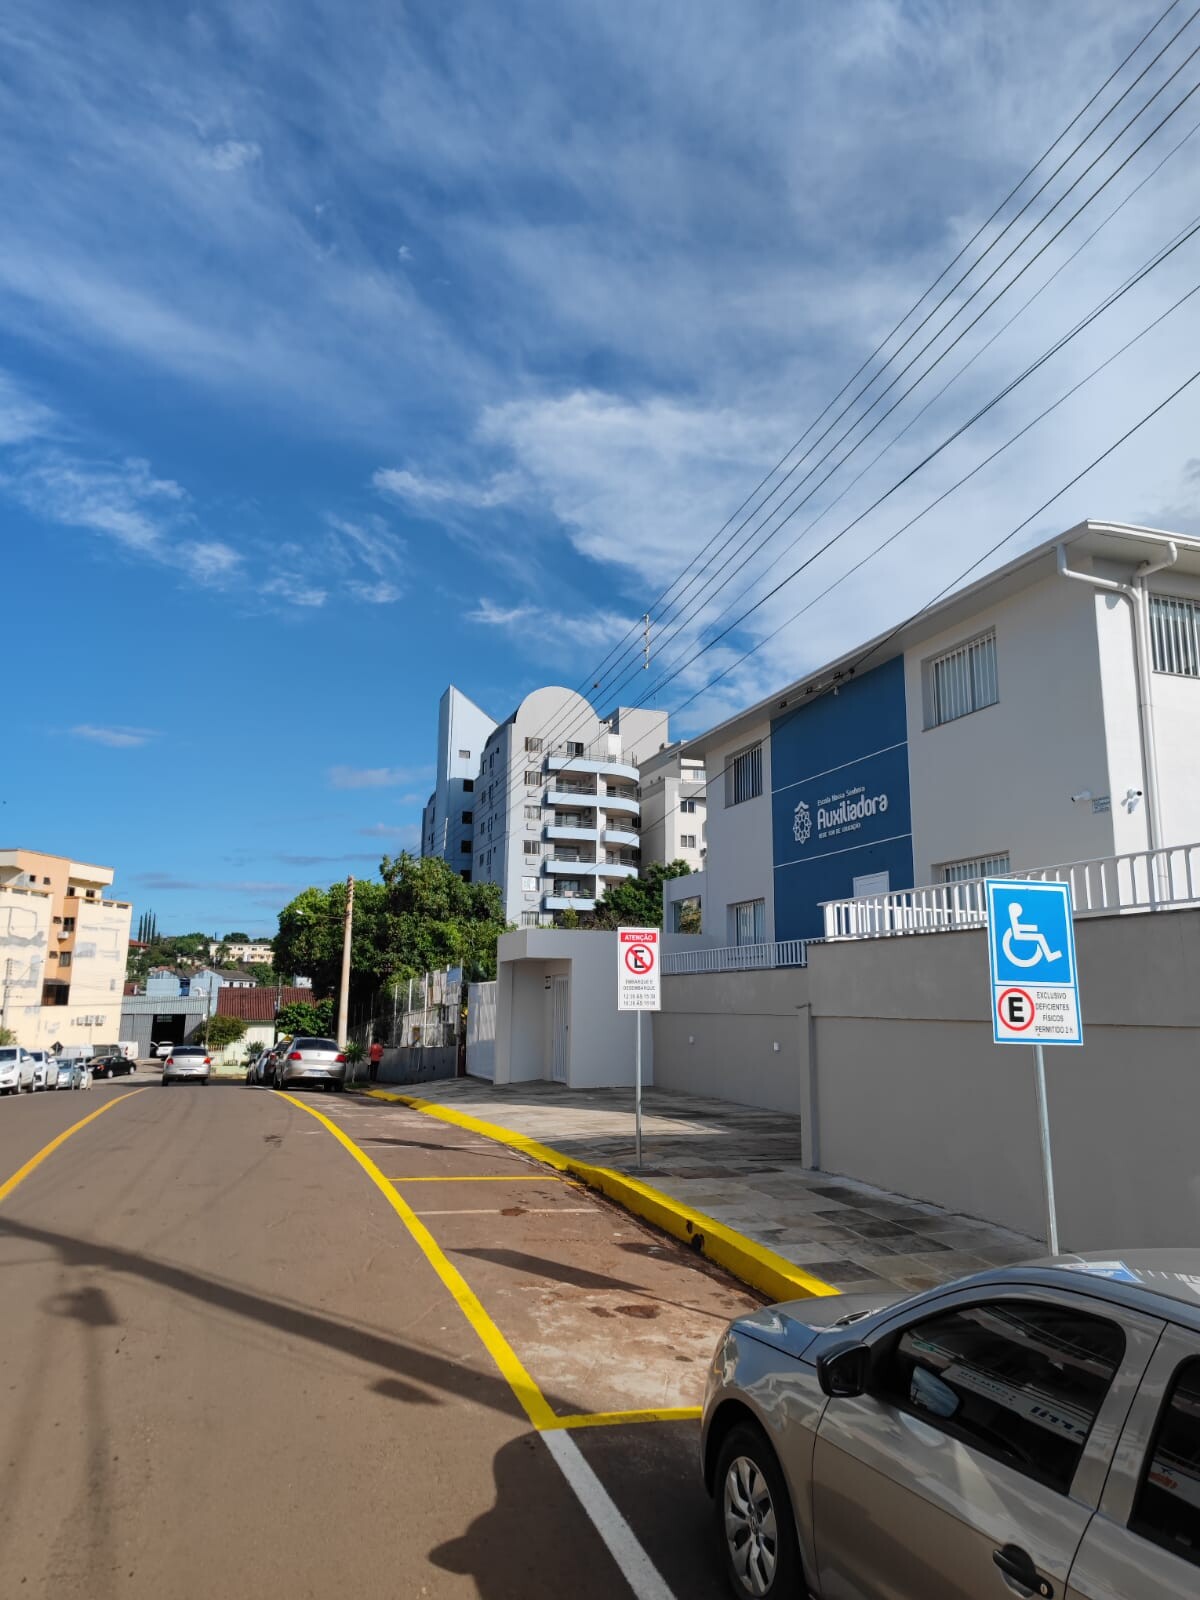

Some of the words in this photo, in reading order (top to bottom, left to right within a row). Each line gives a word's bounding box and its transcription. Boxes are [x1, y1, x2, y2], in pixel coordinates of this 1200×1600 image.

[817, 794, 888, 830] Auxiliadora
[624, 934, 653, 942] ATENÇÃO
[1036, 992, 1066, 1000] EXCLUSIVO
[1008, 996, 1024, 1022] E
[1042, 1012, 1064, 1022] FÍSICOS
